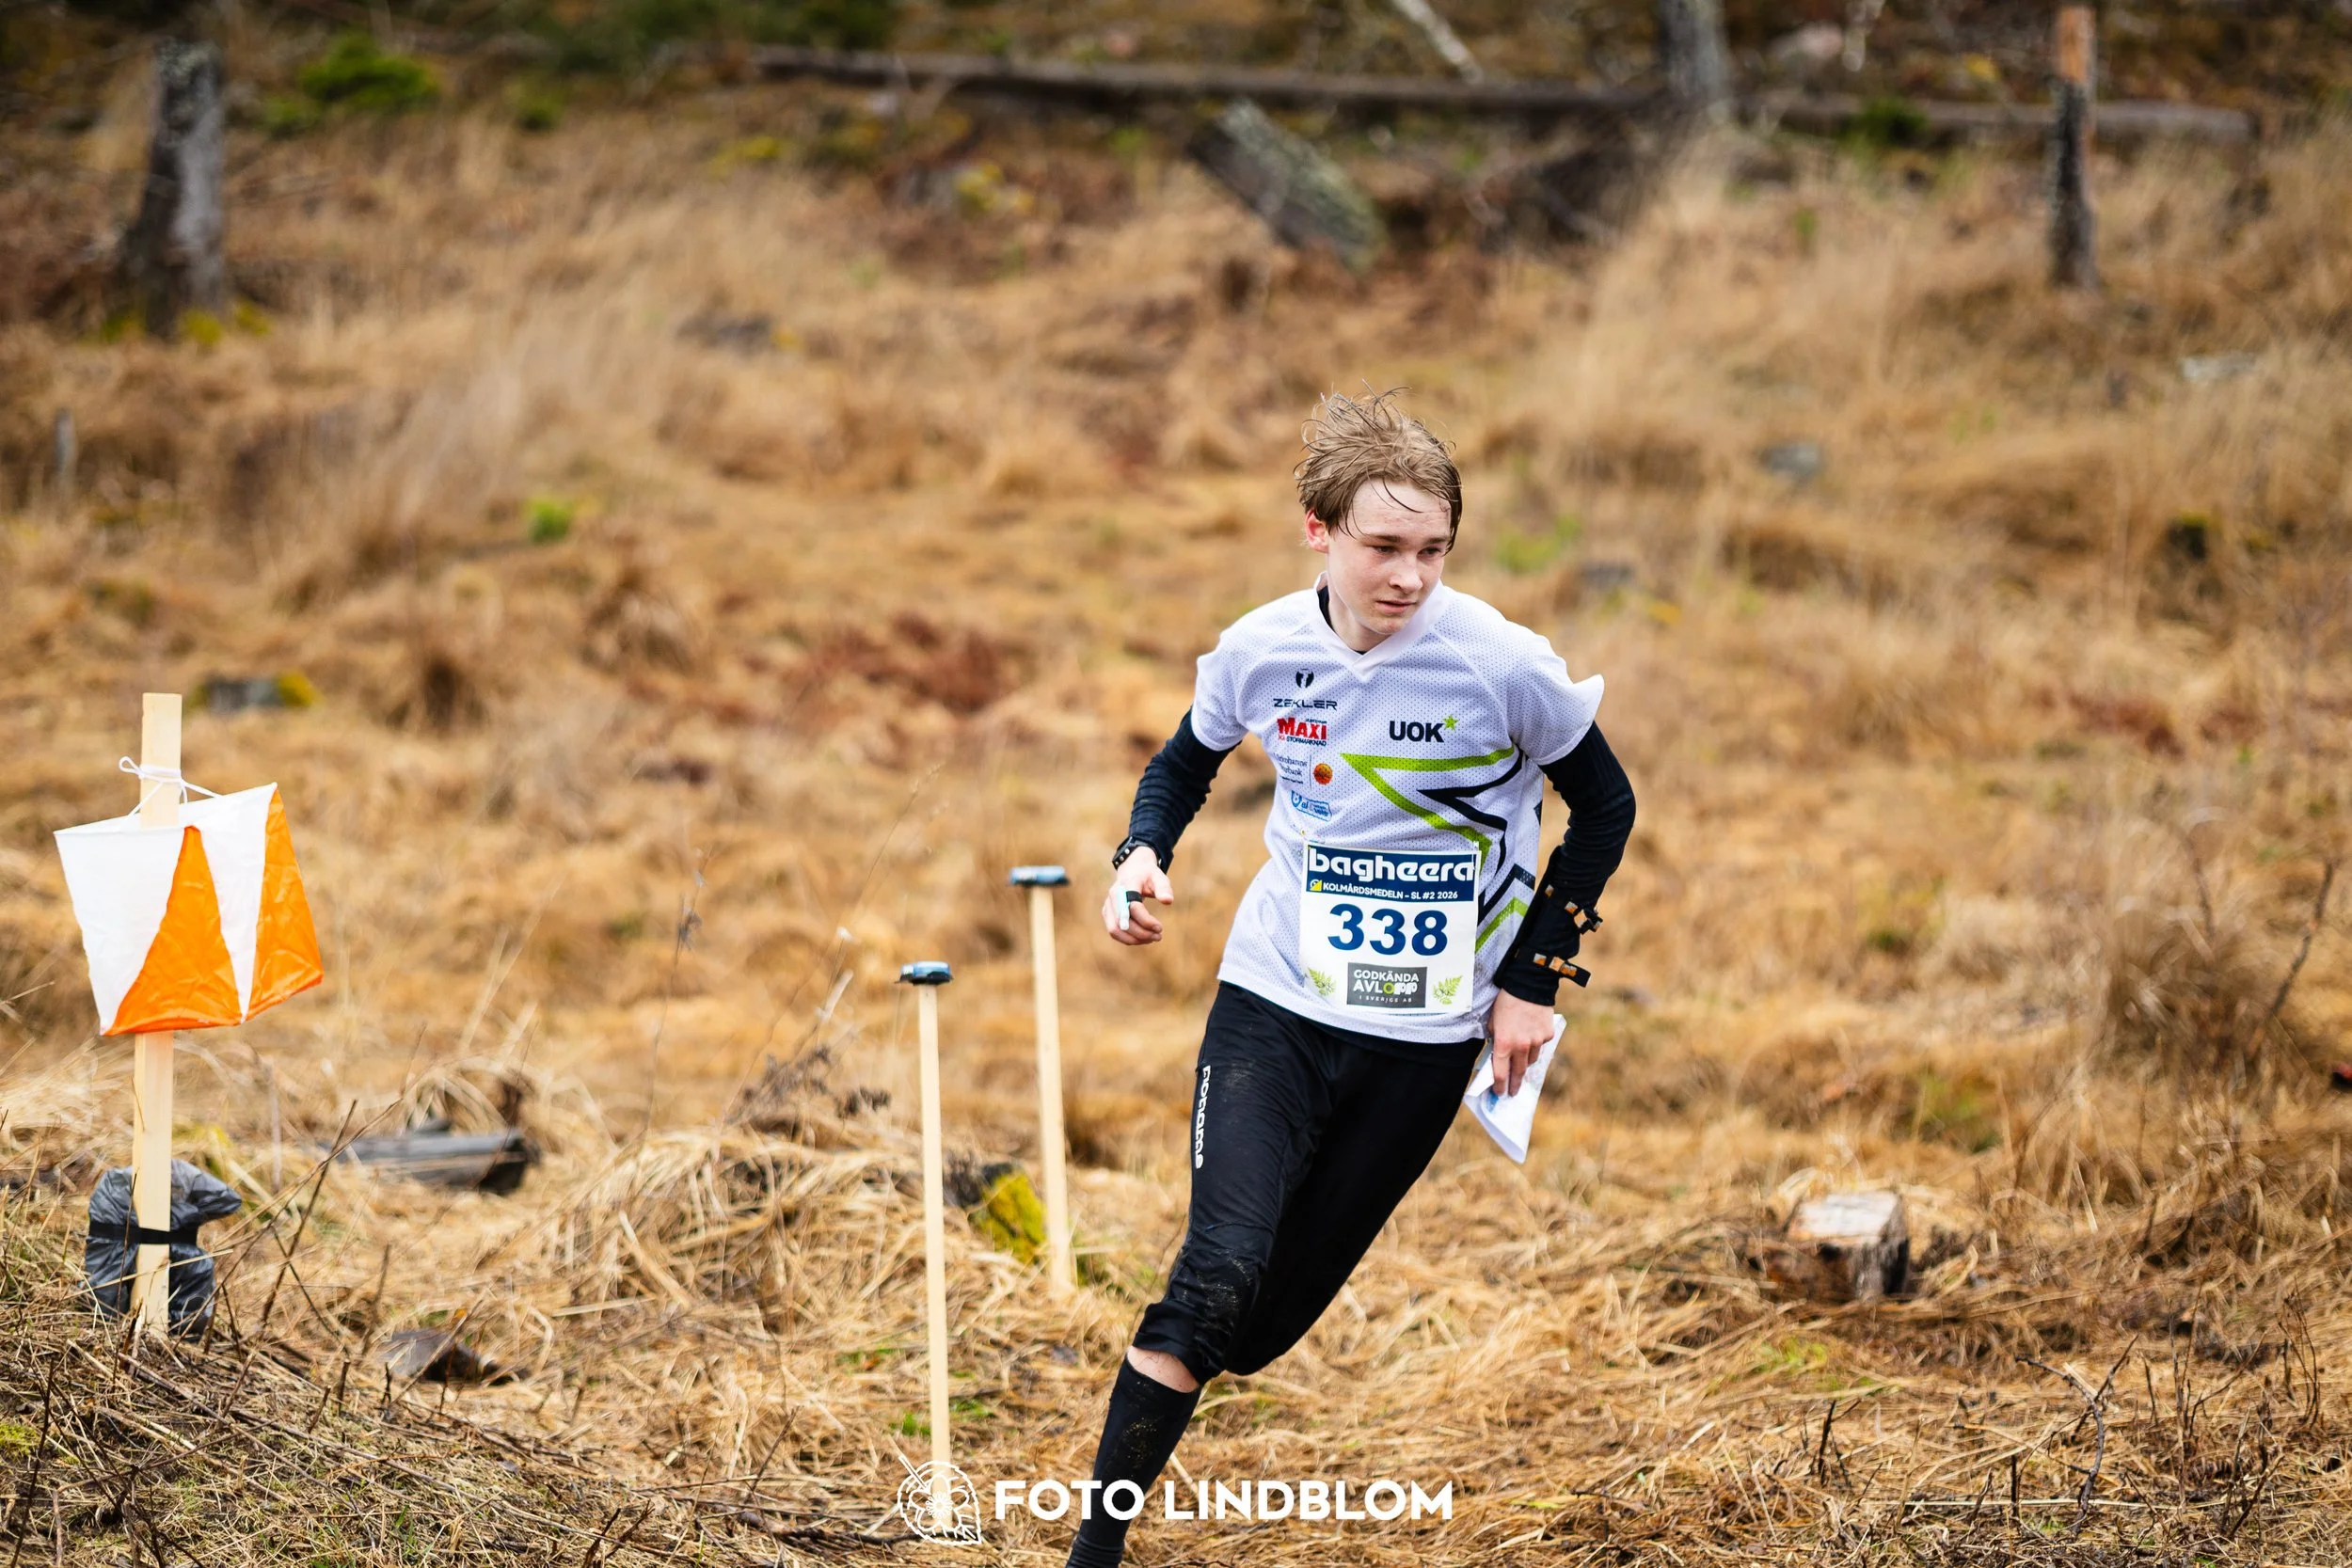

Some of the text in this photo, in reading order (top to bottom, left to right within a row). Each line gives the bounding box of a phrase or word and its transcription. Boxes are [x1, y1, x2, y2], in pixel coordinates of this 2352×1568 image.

[1273, 698, 1338, 711] ZEKLER
[1277, 717, 1327, 740] MAXI
[1389, 721, 1444, 743] UOK
[1308, 846, 1474, 882] bagheera
[1323, 881, 1404, 900] KOLMÅRDSMEDELN
[1411, 891, 1422, 900] SL
[1422, 891, 1436, 900] #2
[1437, 891, 1458, 899] 2026
[1327, 903, 1448, 957] 338
[1353, 969, 1420, 983] GODKÄNDA
[1195, 1065, 1212, 1169] noname
